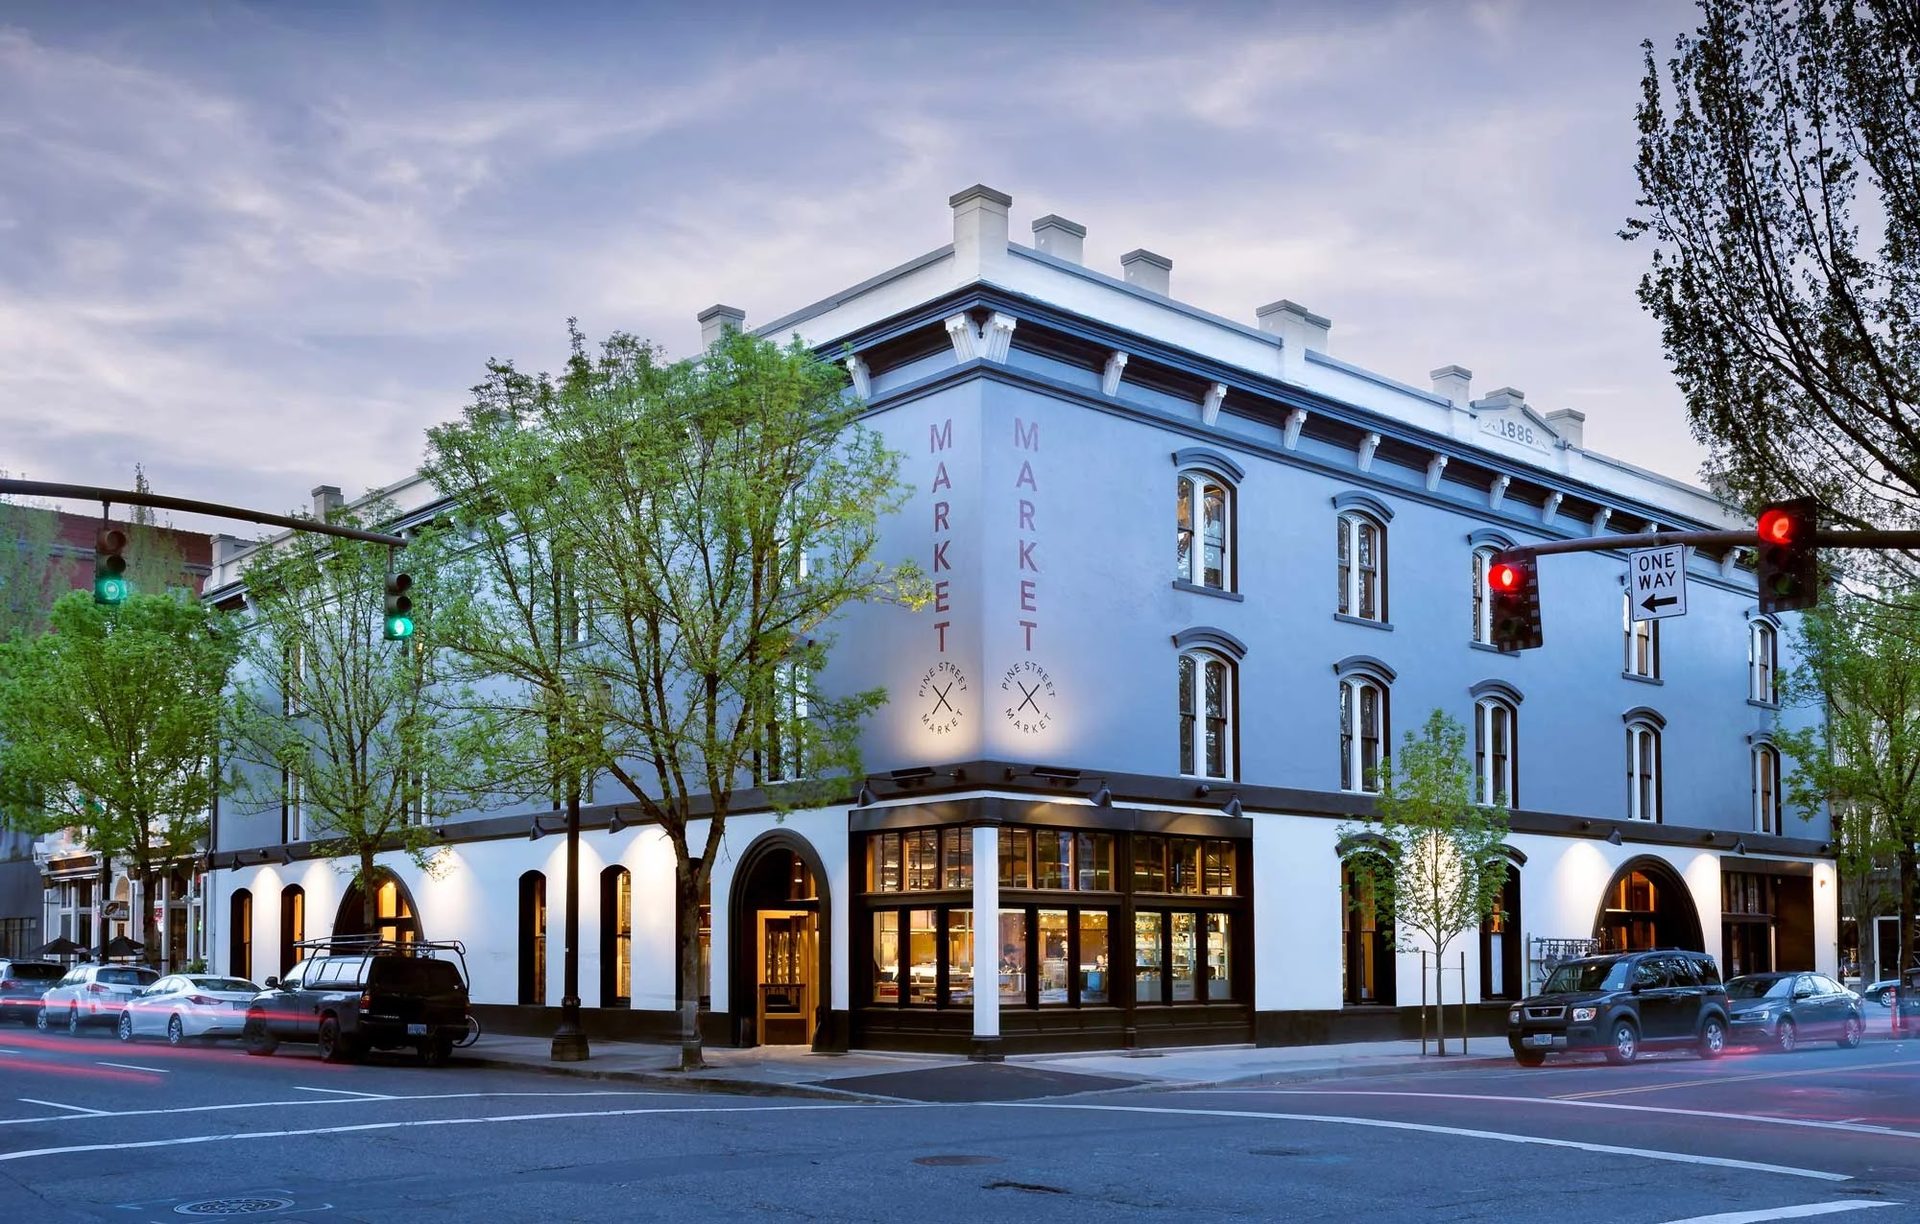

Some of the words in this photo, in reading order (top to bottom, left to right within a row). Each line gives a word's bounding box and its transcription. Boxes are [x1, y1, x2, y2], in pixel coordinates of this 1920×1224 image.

[1500, 418, 1533, 445] 1886
[930, 418, 952, 652] MARKET
[1013, 417, 1039, 651] MARKET
[1639, 552, 1675, 572] ONE
[1639, 570, 1676, 590] WAY
[919, 667, 936, 698] PINE
[938, 662, 967, 691] STREET
[1001, 663, 1021, 691] PINE
[1024, 660, 1056, 698] STREET
[921, 708, 963, 735] MARKET
[1005, 707, 1052, 734] MARKET
